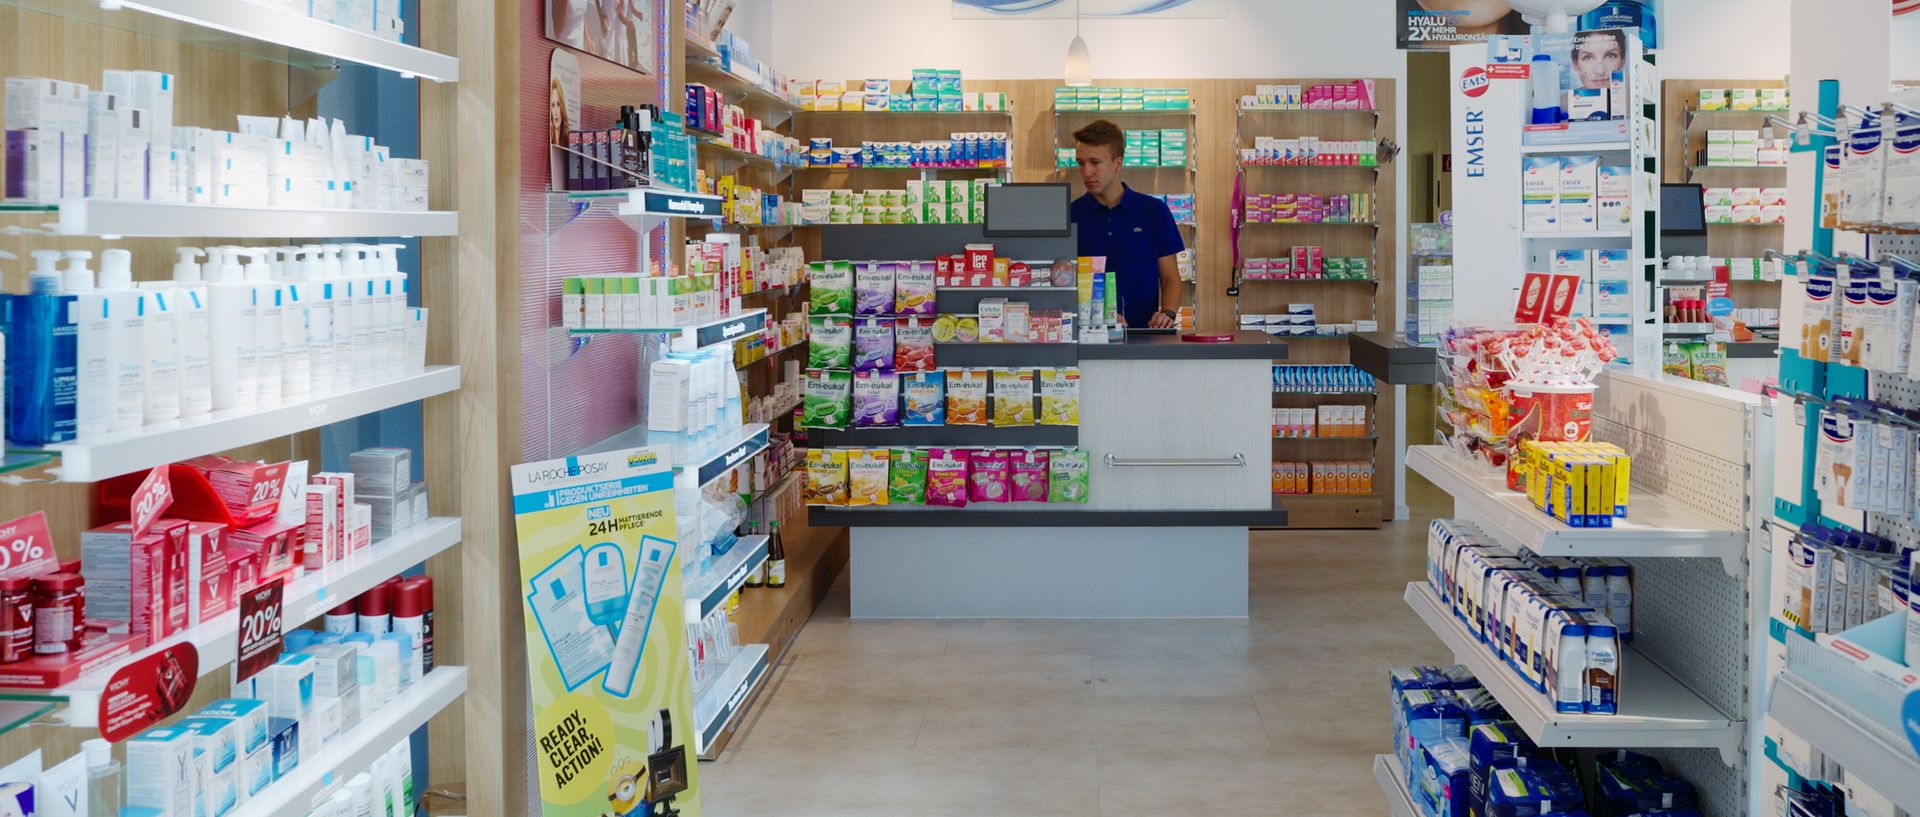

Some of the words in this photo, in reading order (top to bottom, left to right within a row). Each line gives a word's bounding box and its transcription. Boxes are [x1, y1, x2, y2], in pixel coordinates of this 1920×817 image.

[1408, 16, 1446, 26] HYALU
[1408, 27, 1431, 41] 2X
[1463, 74, 1487, 90] EMS
[1466, 110, 1484, 178] EMSER
[973, 252, 988, 262] ipa
[973, 261, 986, 269] lat
[808, 382, 845, 390] Em-eukal
[855, 381, 893, 389] Em-eukal
[949, 381, 983, 389] Em-eukal
[528, 472, 542, 483] LA
[542, 465, 578, 480] ROCHE
[578, 462, 608, 475] POSAY
[253, 479, 280, 503] 20%
[559, 480, 622, 498] PRODUKTSERIE
[136, 477, 166, 525] 20%
[560, 492, 588, 506] GEGEN
[588, 507, 610, 519] NEU
[618, 510, 663, 524] MATTIERENDE
[589, 518, 619, 536] 24H
[240, 603, 281, 649] 20%
[540, 709, 587, 754] READY,
[550, 727, 594, 768] CLEAR,
[555, 737, 604, 790] ACTION!
